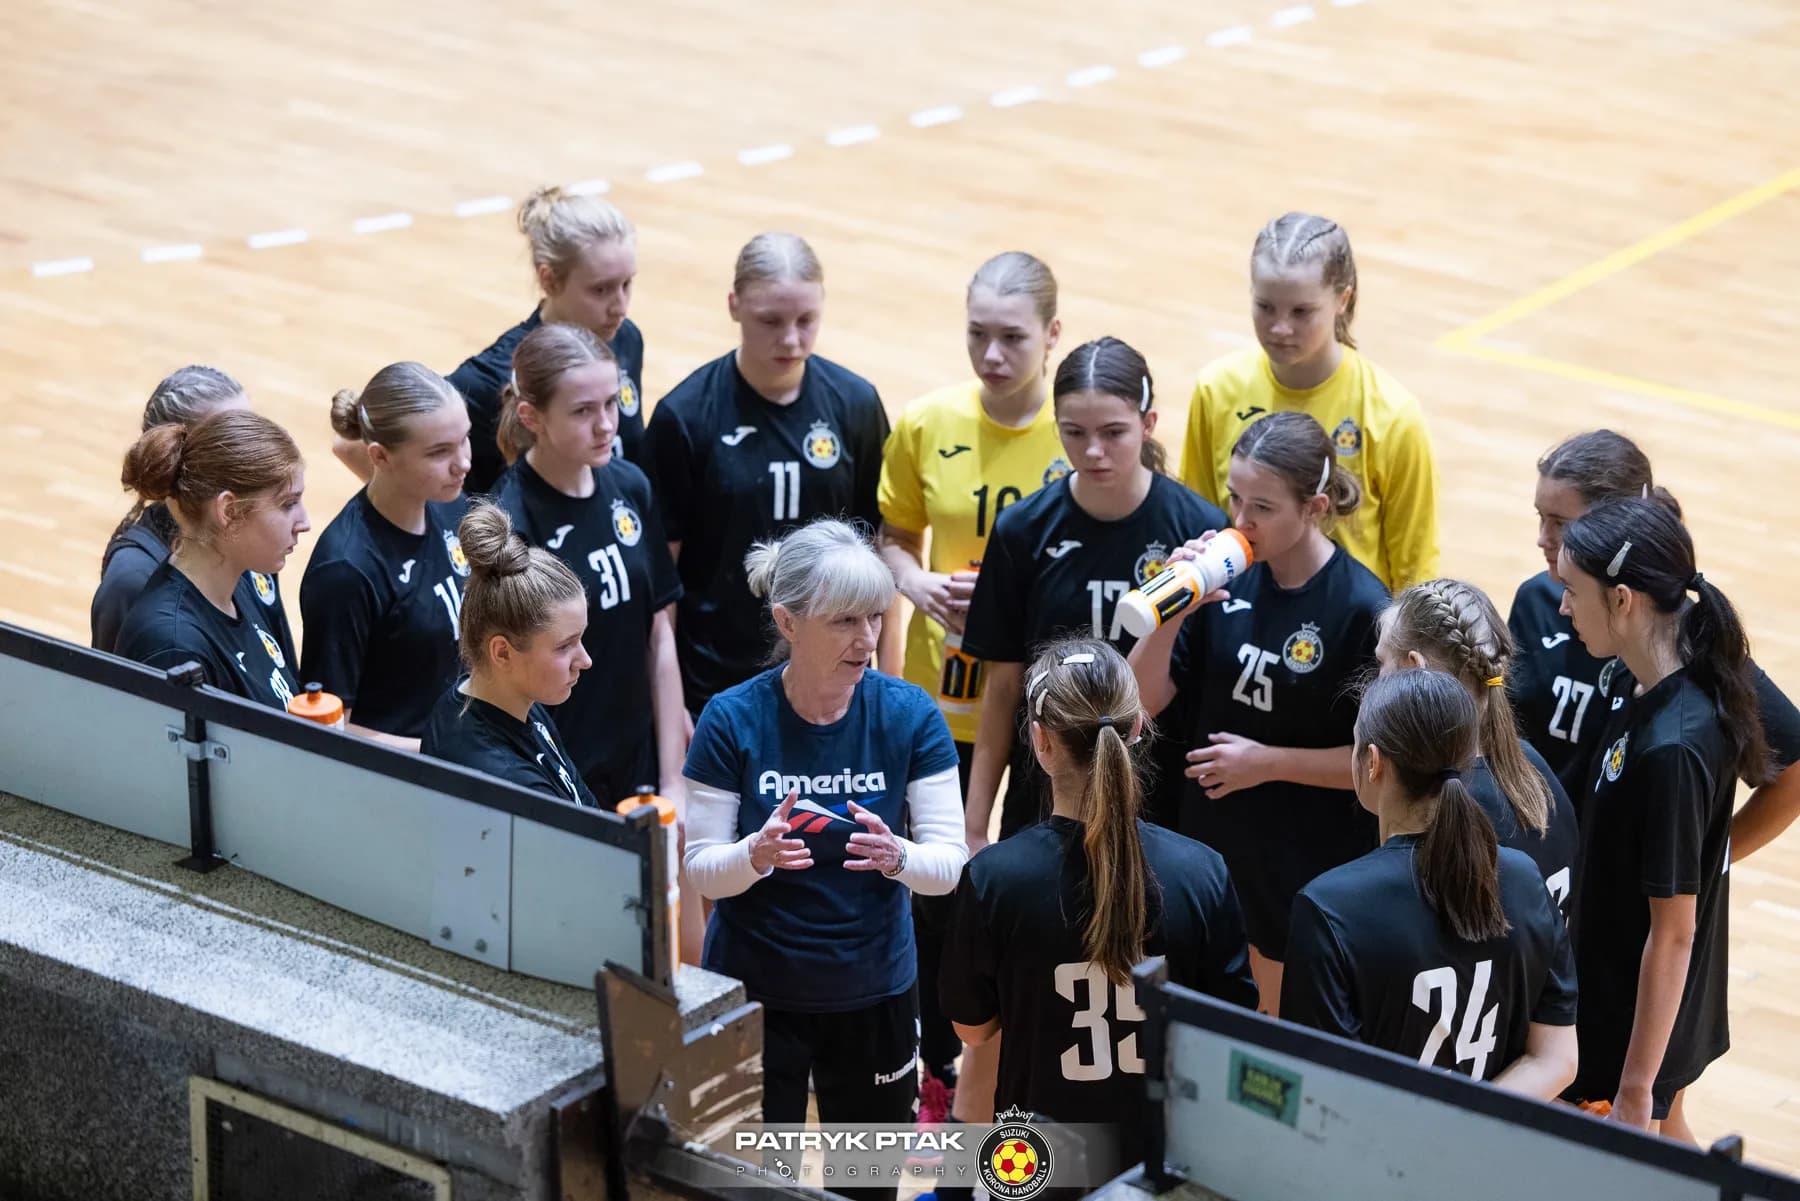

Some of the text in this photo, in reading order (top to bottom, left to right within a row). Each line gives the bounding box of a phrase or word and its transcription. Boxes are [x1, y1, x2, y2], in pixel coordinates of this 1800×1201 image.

[768, 461, 800, 520] 11
[587, 543, 631, 611] 31
[1086, 580, 1130, 640] 17
[1232, 643, 1281, 712] 25
[1548, 675, 1595, 744] 27
[758, 767, 887, 800] America
[1412, 959, 1500, 1083] 24
